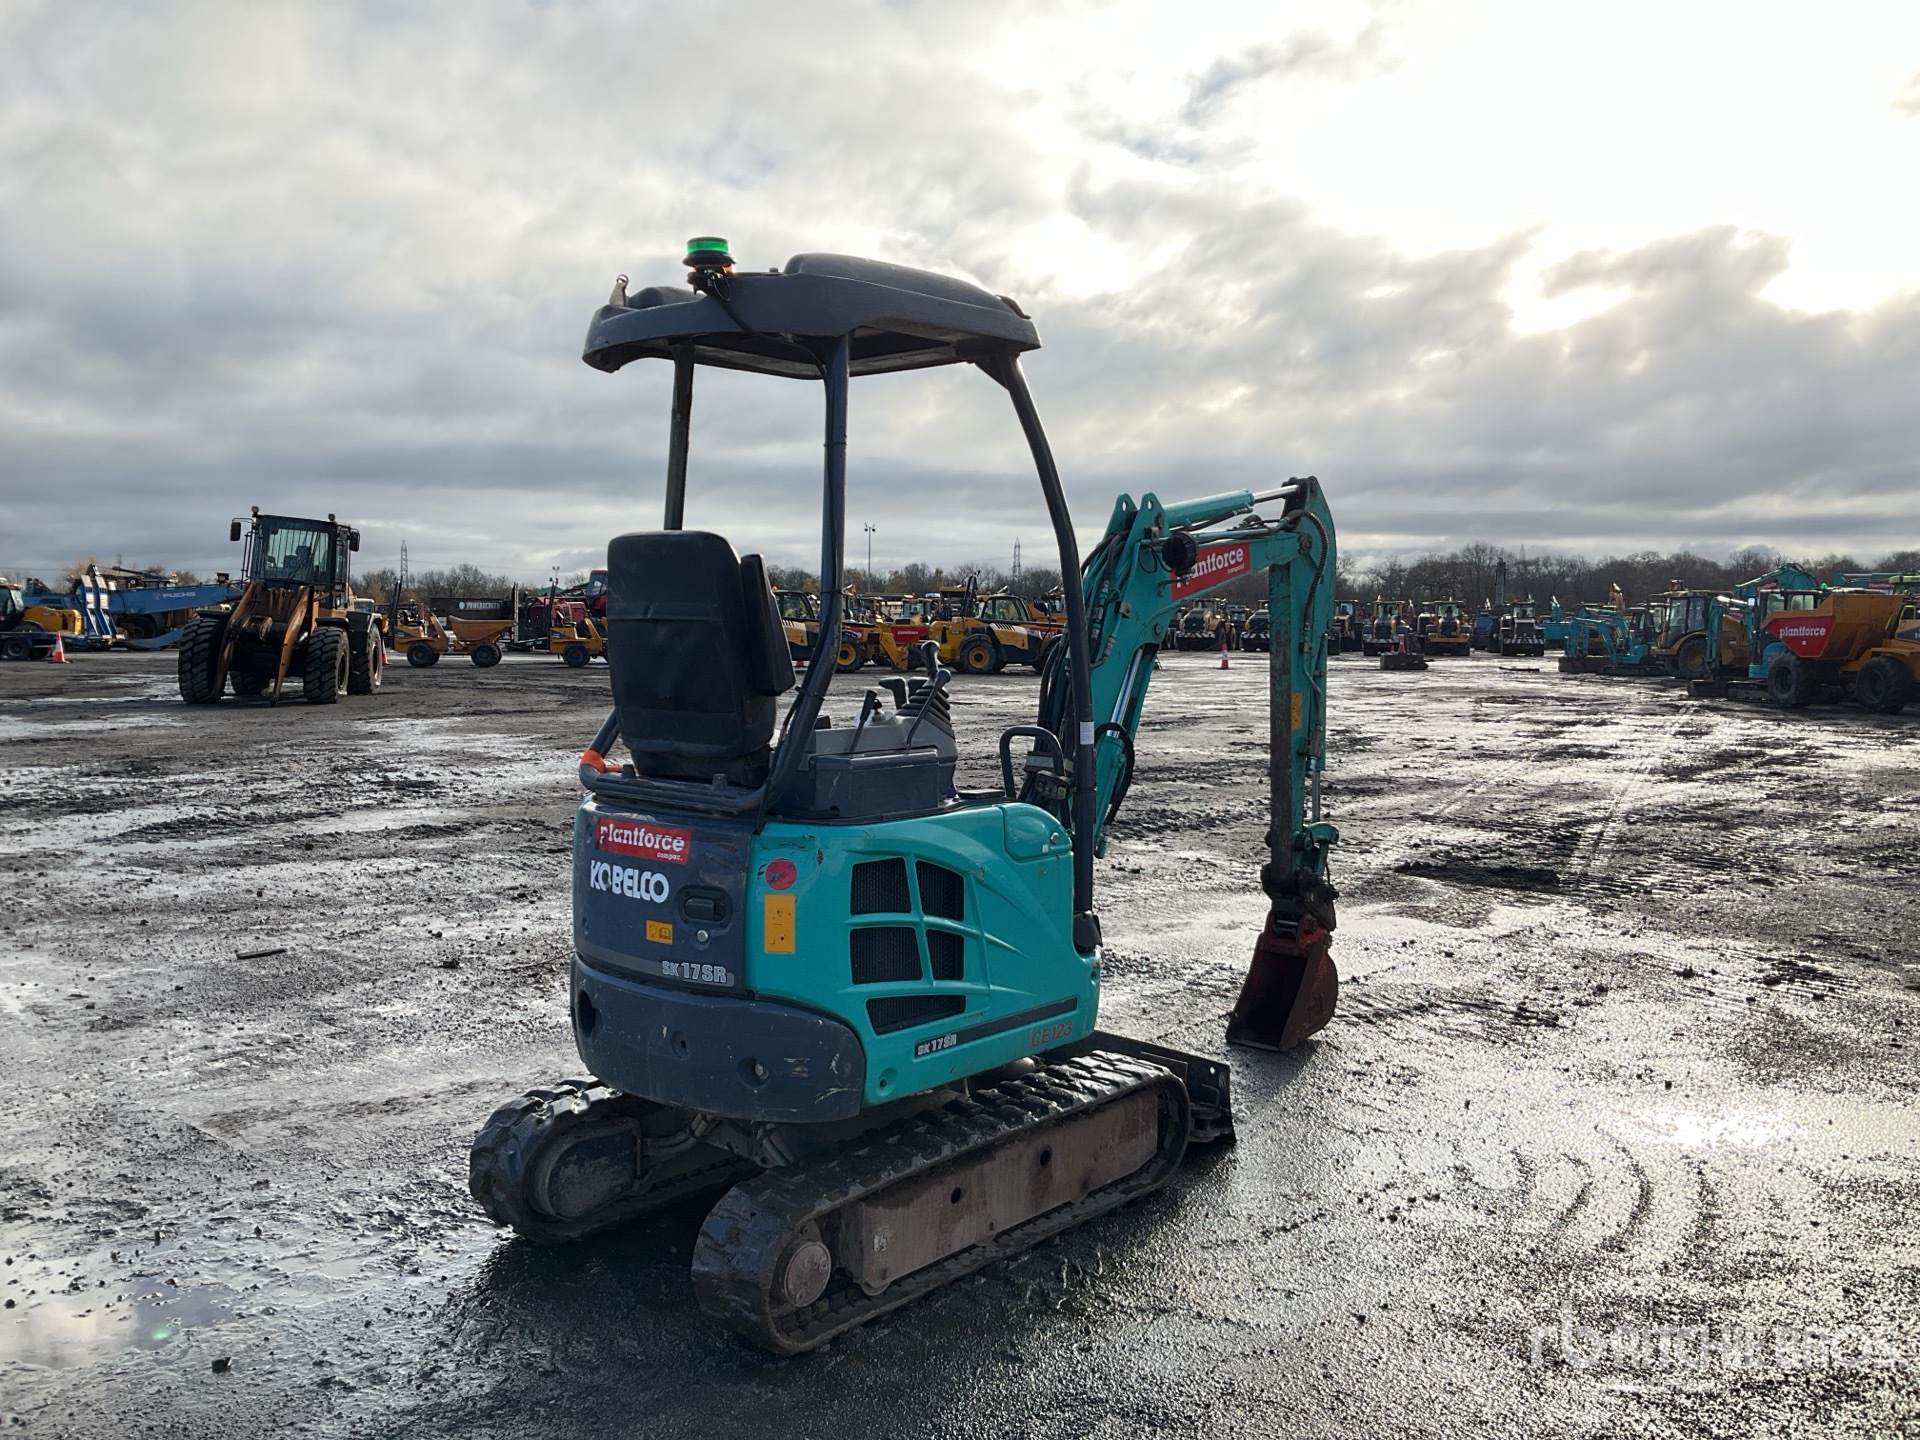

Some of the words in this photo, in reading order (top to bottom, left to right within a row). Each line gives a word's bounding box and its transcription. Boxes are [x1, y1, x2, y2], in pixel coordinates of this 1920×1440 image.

[162, 591, 196, 599] FUCHS
[1780, 626, 1826, 638] plantforce
[590, 860, 670, 904] KOBELCO
